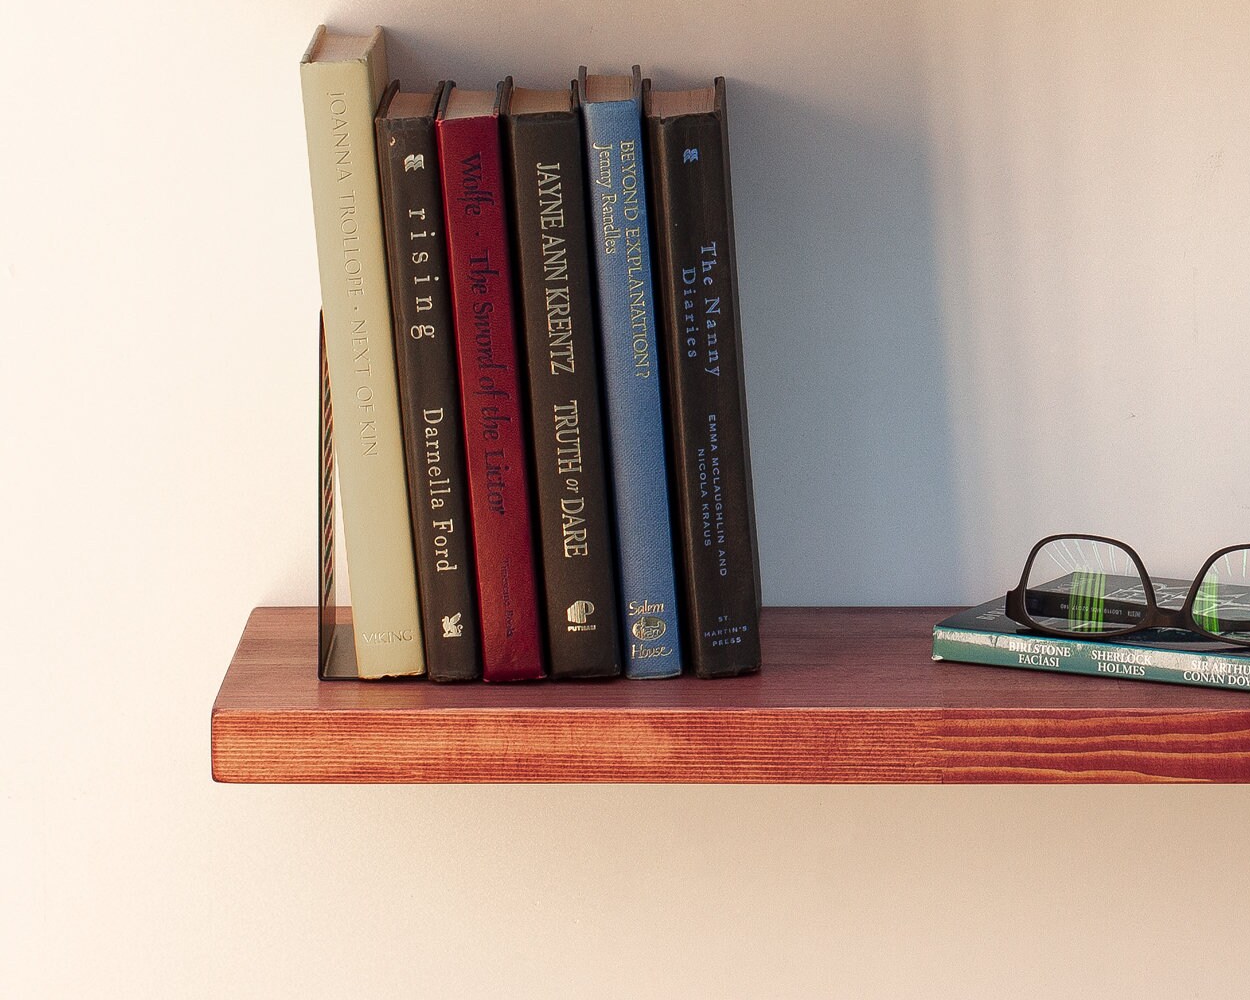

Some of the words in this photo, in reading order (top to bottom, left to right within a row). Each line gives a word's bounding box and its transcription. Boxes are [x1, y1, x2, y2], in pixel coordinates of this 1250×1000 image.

[327, 92, 352, 182] JOANNA
[457, 151, 494, 216] Wolfe
[593, 143, 613, 189] Jenny
[620, 140, 638, 222] BEYOND
[536, 162, 564, 230] JAYNE
[339, 189, 364, 296] TROLLOPE
[602, 192, 621, 254] Randles
[408, 207, 439, 339] rising
[469, 246, 500, 295] The
[542, 233, 568, 281] ANN
[701, 241, 717, 286] The
[626, 226, 650, 379] EXPLANATION?
[682, 266, 699, 358] Diaries
[351, 319, 372, 377] NEXT
[472, 301, 509, 371] Sword
[545, 286, 575, 375] KRENTZ
[705, 296, 721, 377] Nanny
[356, 385, 376, 414] OF
[473, 375, 512, 400] of
[359, 419, 379, 456] KIN
[481, 405, 513, 441] the
[554, 399, 582, 474] TRUTH
[423, 407, 451, 510] Darnella
[698, 448, 708, 498] NICOLA
[565, 477, 579, 493] or
[708, 414, 718, 452] EMMA
[718, 549, 728, 577] AND
[432, 518, 458, 573] Ford
[560, 497, 588, 558] DARE
[702, 503, 711, 546] KRAUS
[628, 599, 665, 616] Salem
[362, 629, 413, 644] VIKING
[631, 644, 673, 659] House
[1008, 641, 1072, 658] BIRLSTONE
[1091, 649, 1152, 666] SHERLOCK
[1097, 661, 1146, 676] HOLMES
[1183, 671, 1225, 684] CONAN
[1190, 659, 1210, 671] SIR
